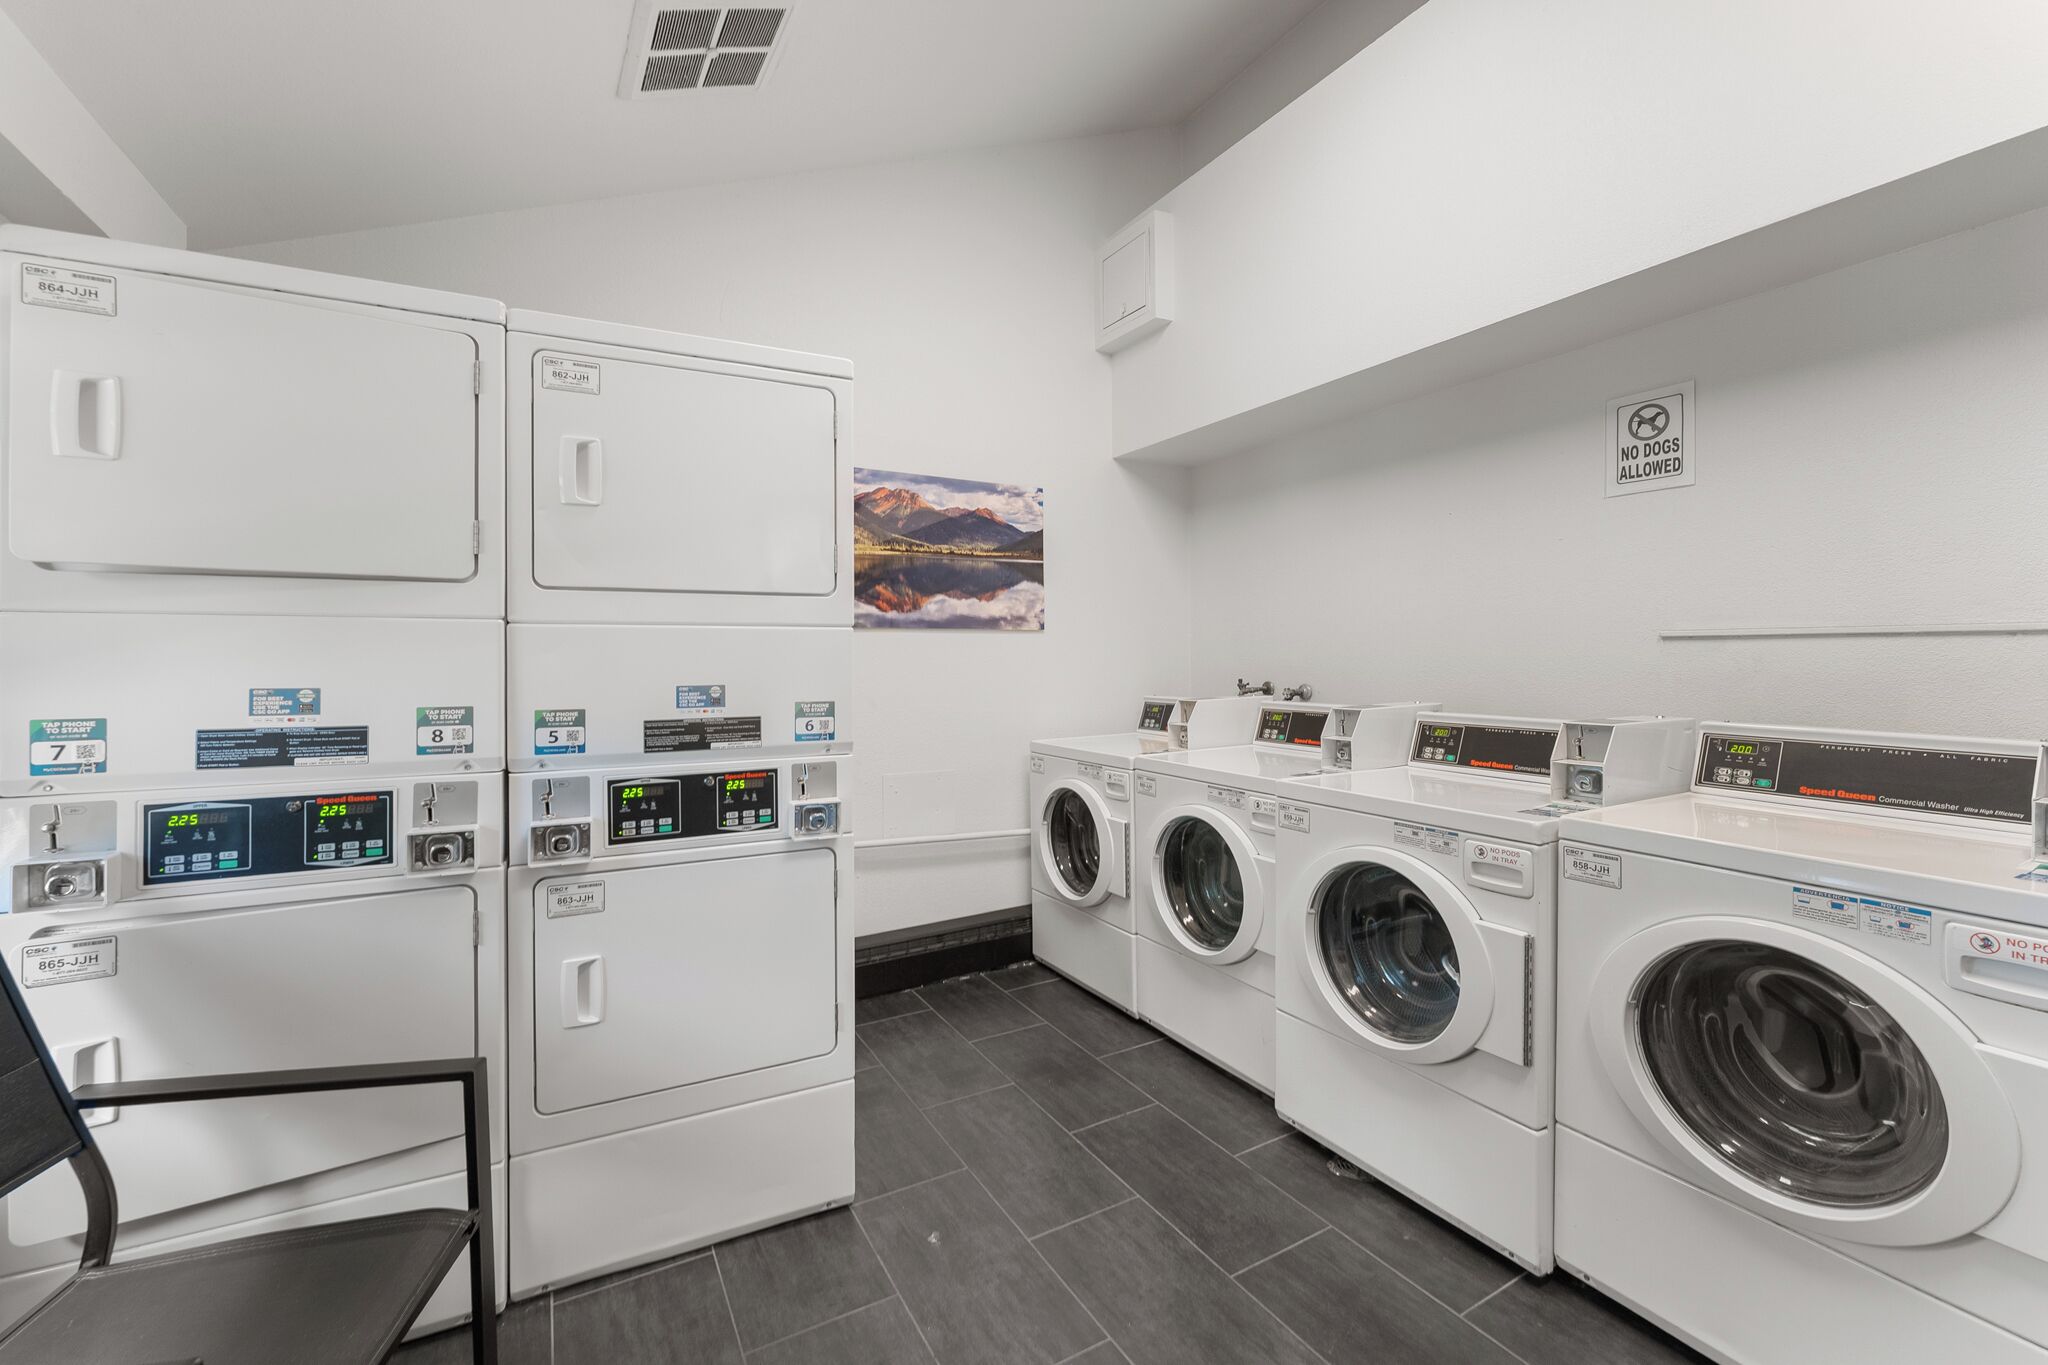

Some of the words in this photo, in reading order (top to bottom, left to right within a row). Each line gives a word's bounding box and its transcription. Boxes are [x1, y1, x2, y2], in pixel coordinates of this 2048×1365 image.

[38, 281, 98, 298] 864-JJH
[552, 370, 589, 382] 862-JJH
[1621, 444, 1639, 462] NO
[1644, 437, 1680, 458] DOGS
[1619, 457, 1681, 481] ALLOWED
[805, 720, 814, 731] 6
[432, 729, 444, 743] 8
[548, 730, 559, 744] 5
[50, 744, 66, 761] 7
[1470, 759, 1491, 768] Speed
[1492, 761, 1513, 770] Queen
[1514, 764, 1540, 773] Commercial
[726, 780, 745, 790] 2.25
[622, 787, 643, 798] 2.25
[316, 796, 347, 805] Speed
[1799, 785, 1836, 797] Speed
[1837, 790, 1876, 802] Queen
[1878, 795, 1926, 807] Commercial
[1927, 801, 1959, 811] Washer
[1994, 810, 2025, 819] Efficiency
[319, 804, 347, 817] 2.25
[168, 814, 198, 827] 2.25
[1502, 849, 1520, 858] PODS
[1573, 860, 1610, 874] 858-JJH
[557, 894, 594, 905] 863-JJH
[1800, 888, 1850, 901] ADVERTENCIA
[1880, 902, 1910, 912] NOTICE
[2006, 938, 2028, 949] NO
[26, 947, 49, 955] CSC
[2011, 951, 2026, 961] IN
[38, 954, 99, 970] 865-JJH
